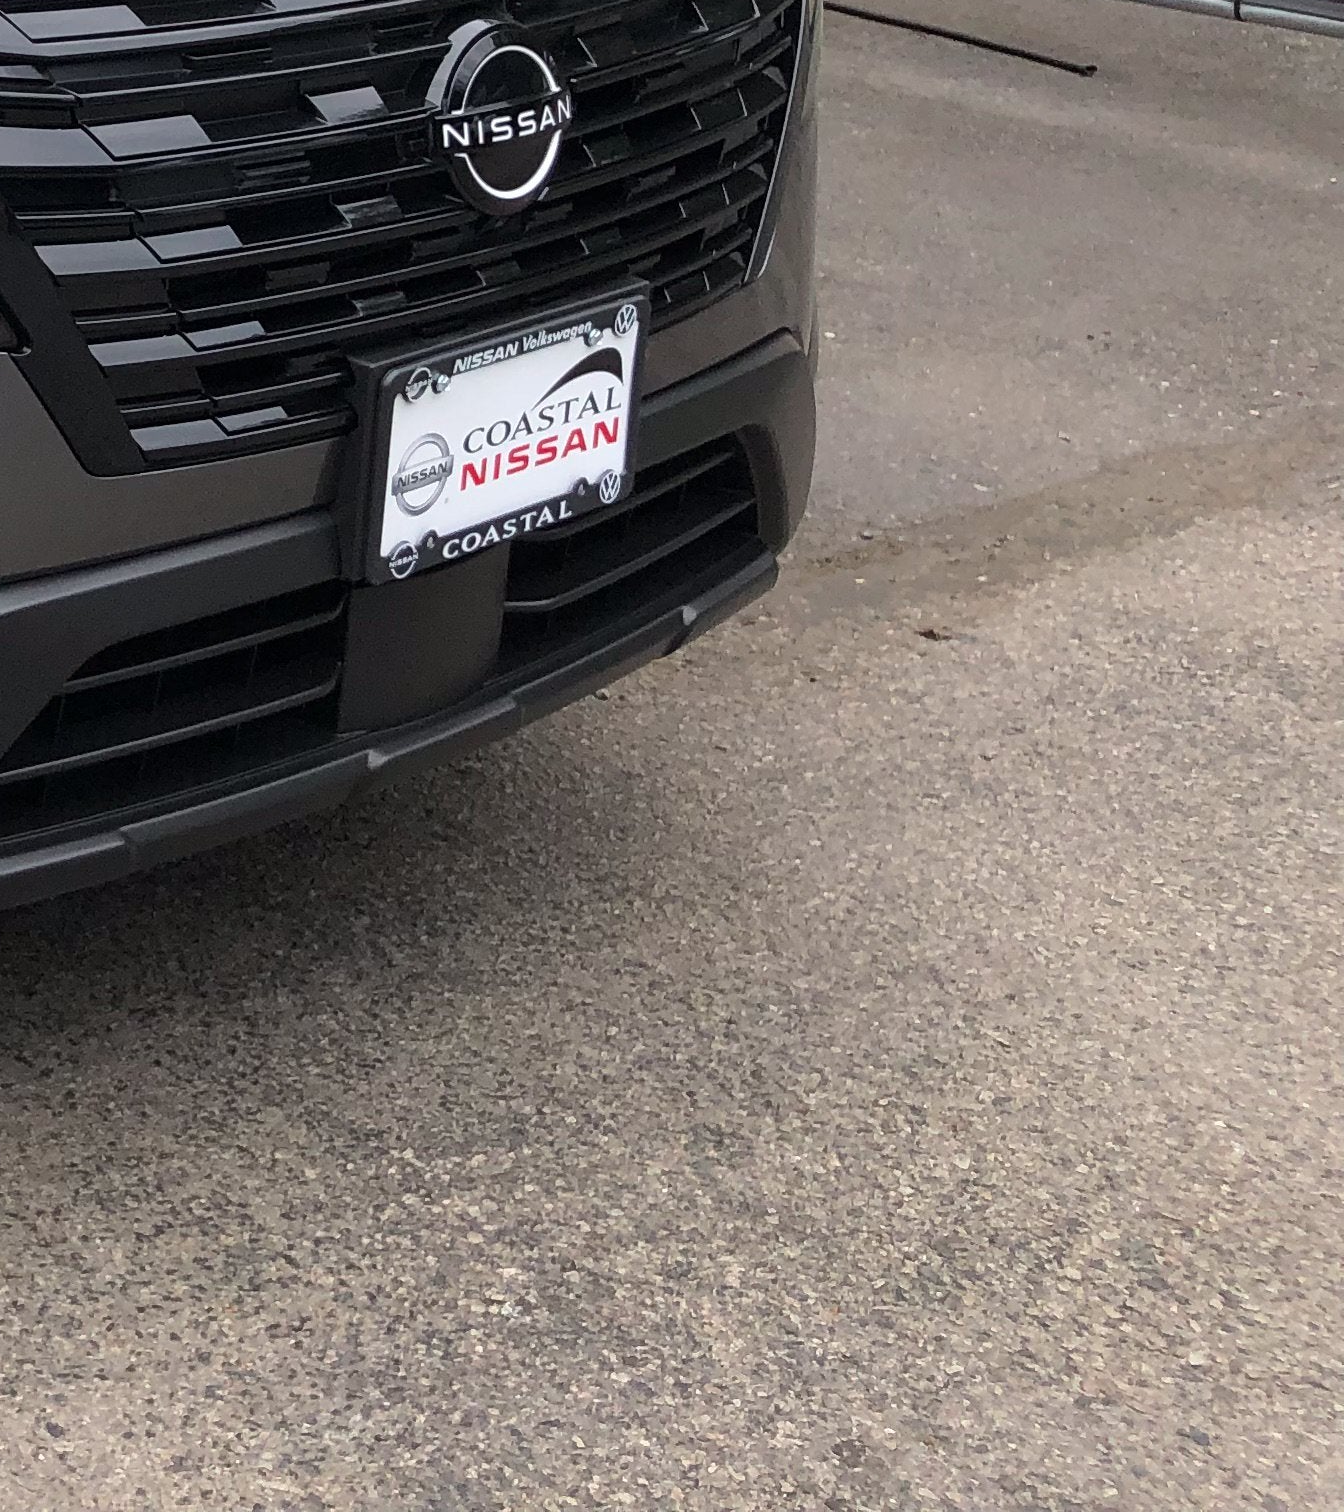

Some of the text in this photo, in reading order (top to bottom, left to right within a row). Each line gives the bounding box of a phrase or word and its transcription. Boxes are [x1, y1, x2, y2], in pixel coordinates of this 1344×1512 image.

[442, 94, 572, 149] NISSAN
[453, 320, 593, 374] NISSAN Volkswagen
[462, 386, 622, 454] COASTAL
[397, 460, 449, 488] NISSAN
[460, 416, 620, 492] NISSAN
[442, 500, 573, 560] COASTAL
